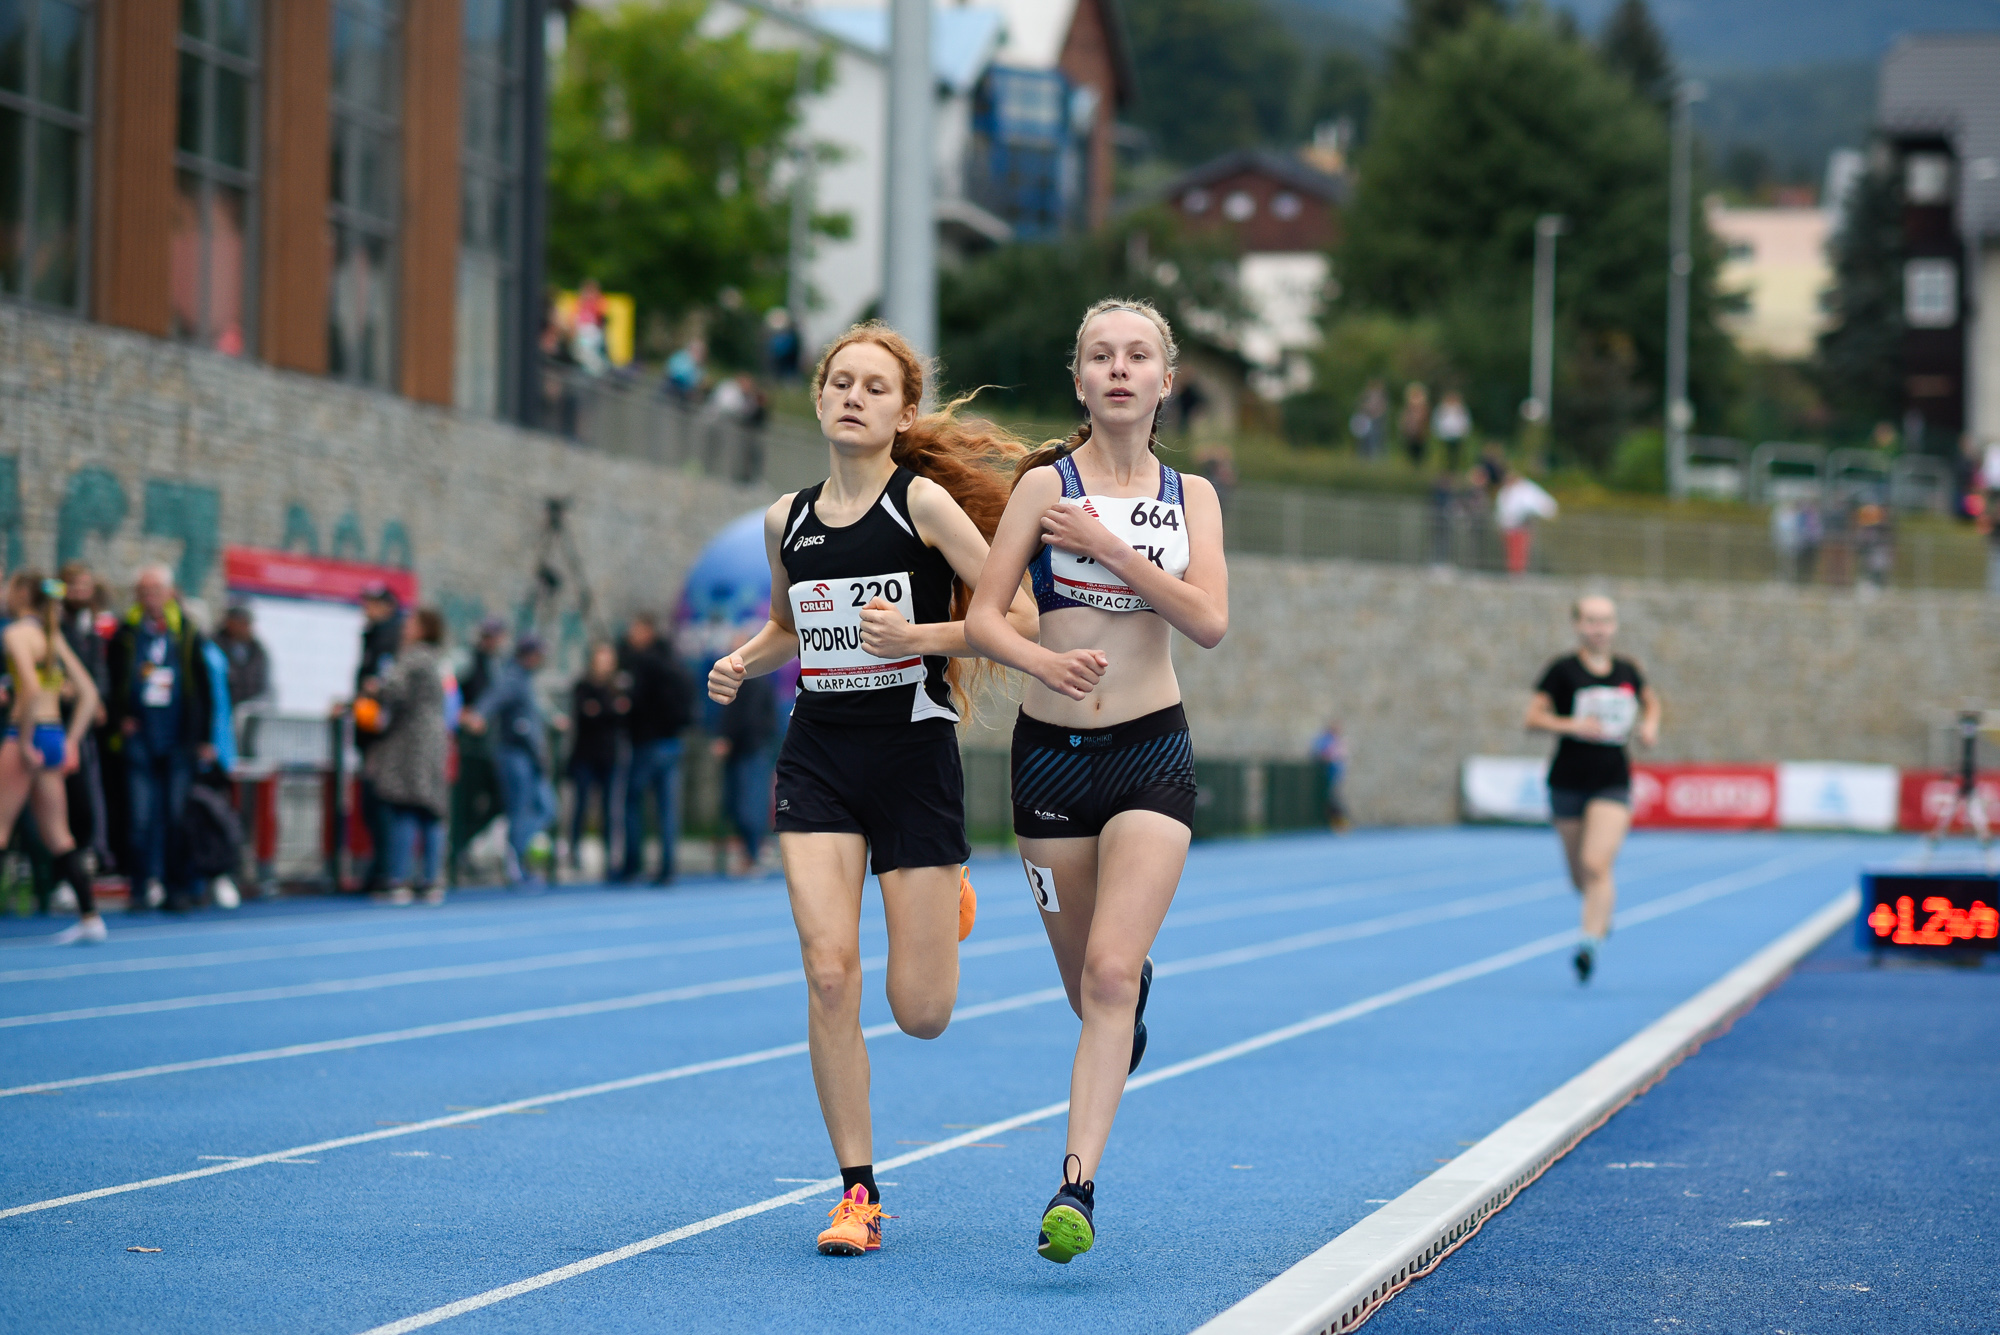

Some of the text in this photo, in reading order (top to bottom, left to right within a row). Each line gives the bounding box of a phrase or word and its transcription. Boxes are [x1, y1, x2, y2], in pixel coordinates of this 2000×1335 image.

[1130, 502, 1180, 532] 664
[801, 601, 832, 611] ORLEN
[849, 579, 903, 608] 220
[1070, 588, 1132, 610] KARPACZ
[816, 672, 904, 690] KARPACZ 2021
[1031, 867, 1049, 907] 3
